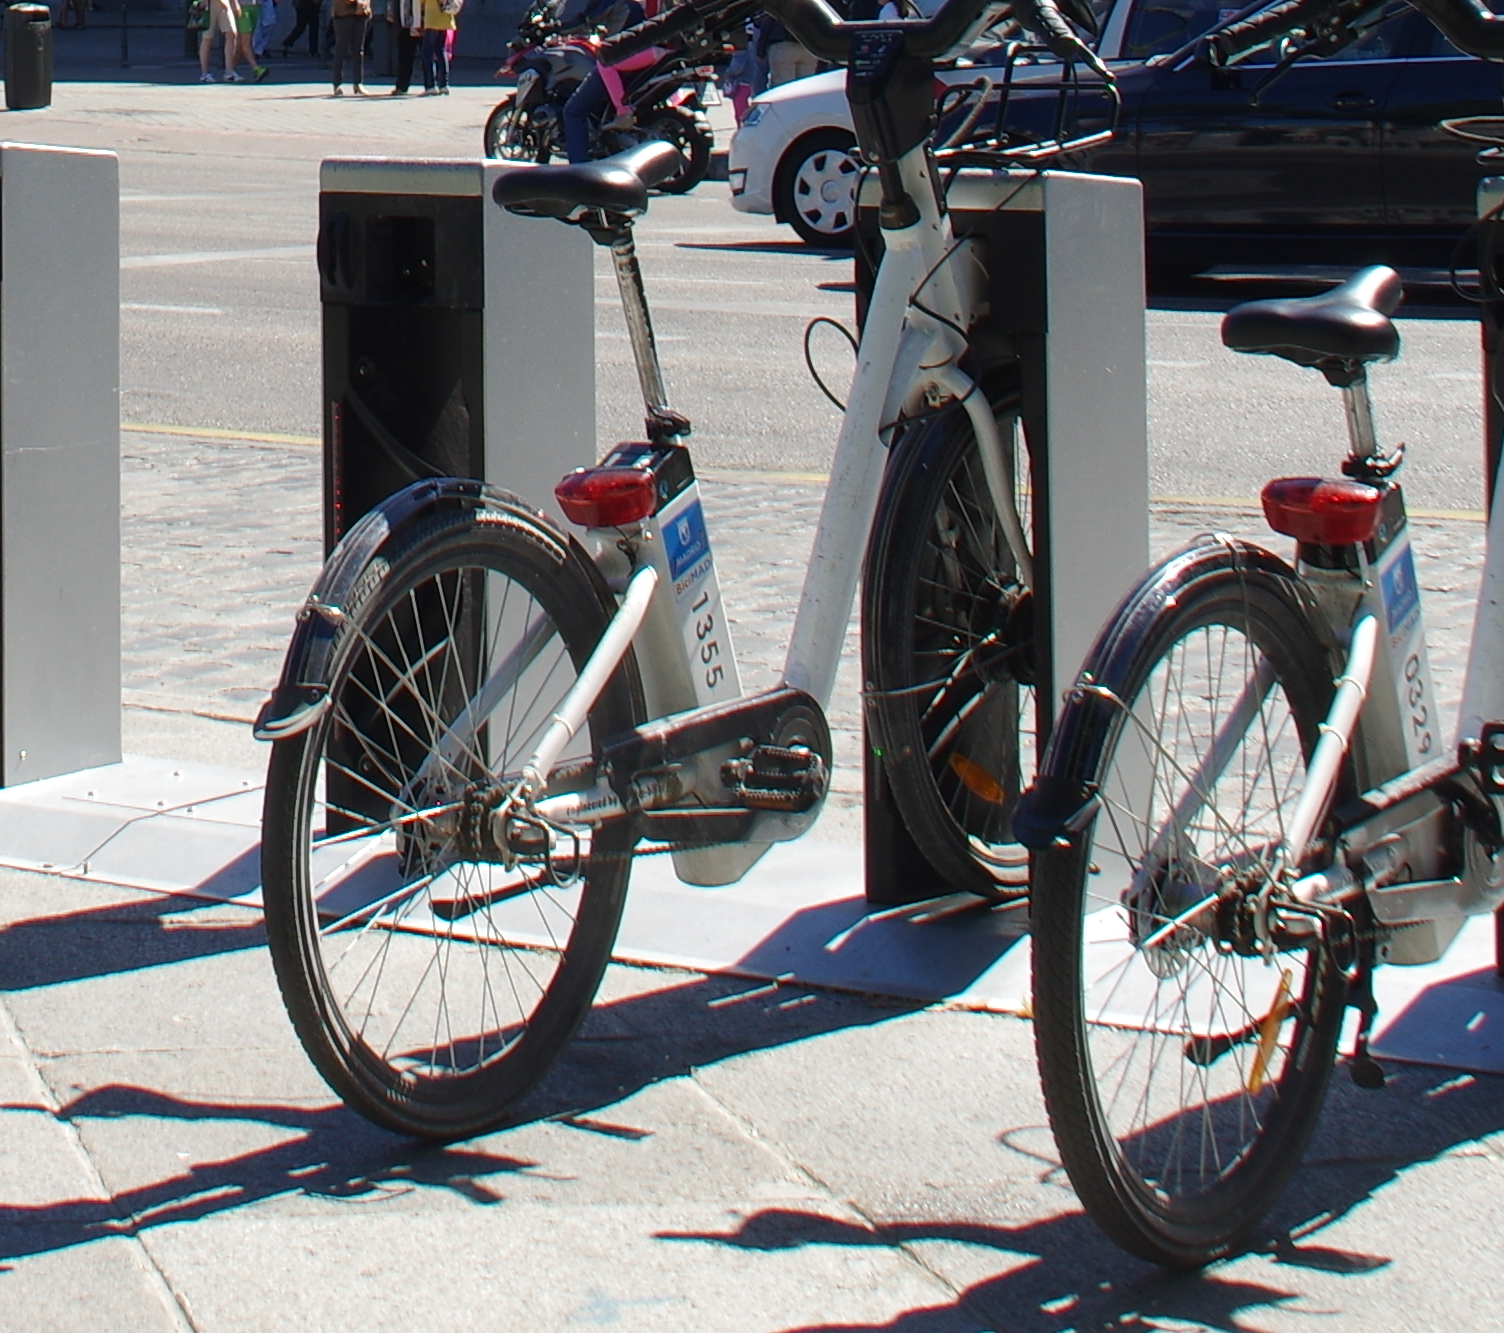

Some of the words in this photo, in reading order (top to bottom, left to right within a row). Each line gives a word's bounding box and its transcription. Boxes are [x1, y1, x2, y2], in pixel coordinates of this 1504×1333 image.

[675, 539, 702, 566] MADRID
[675, 556, 712, 596] BiciMAD
[692, 591, 724, 689] 1355
[1404, 653, 1432, 755] 0329
